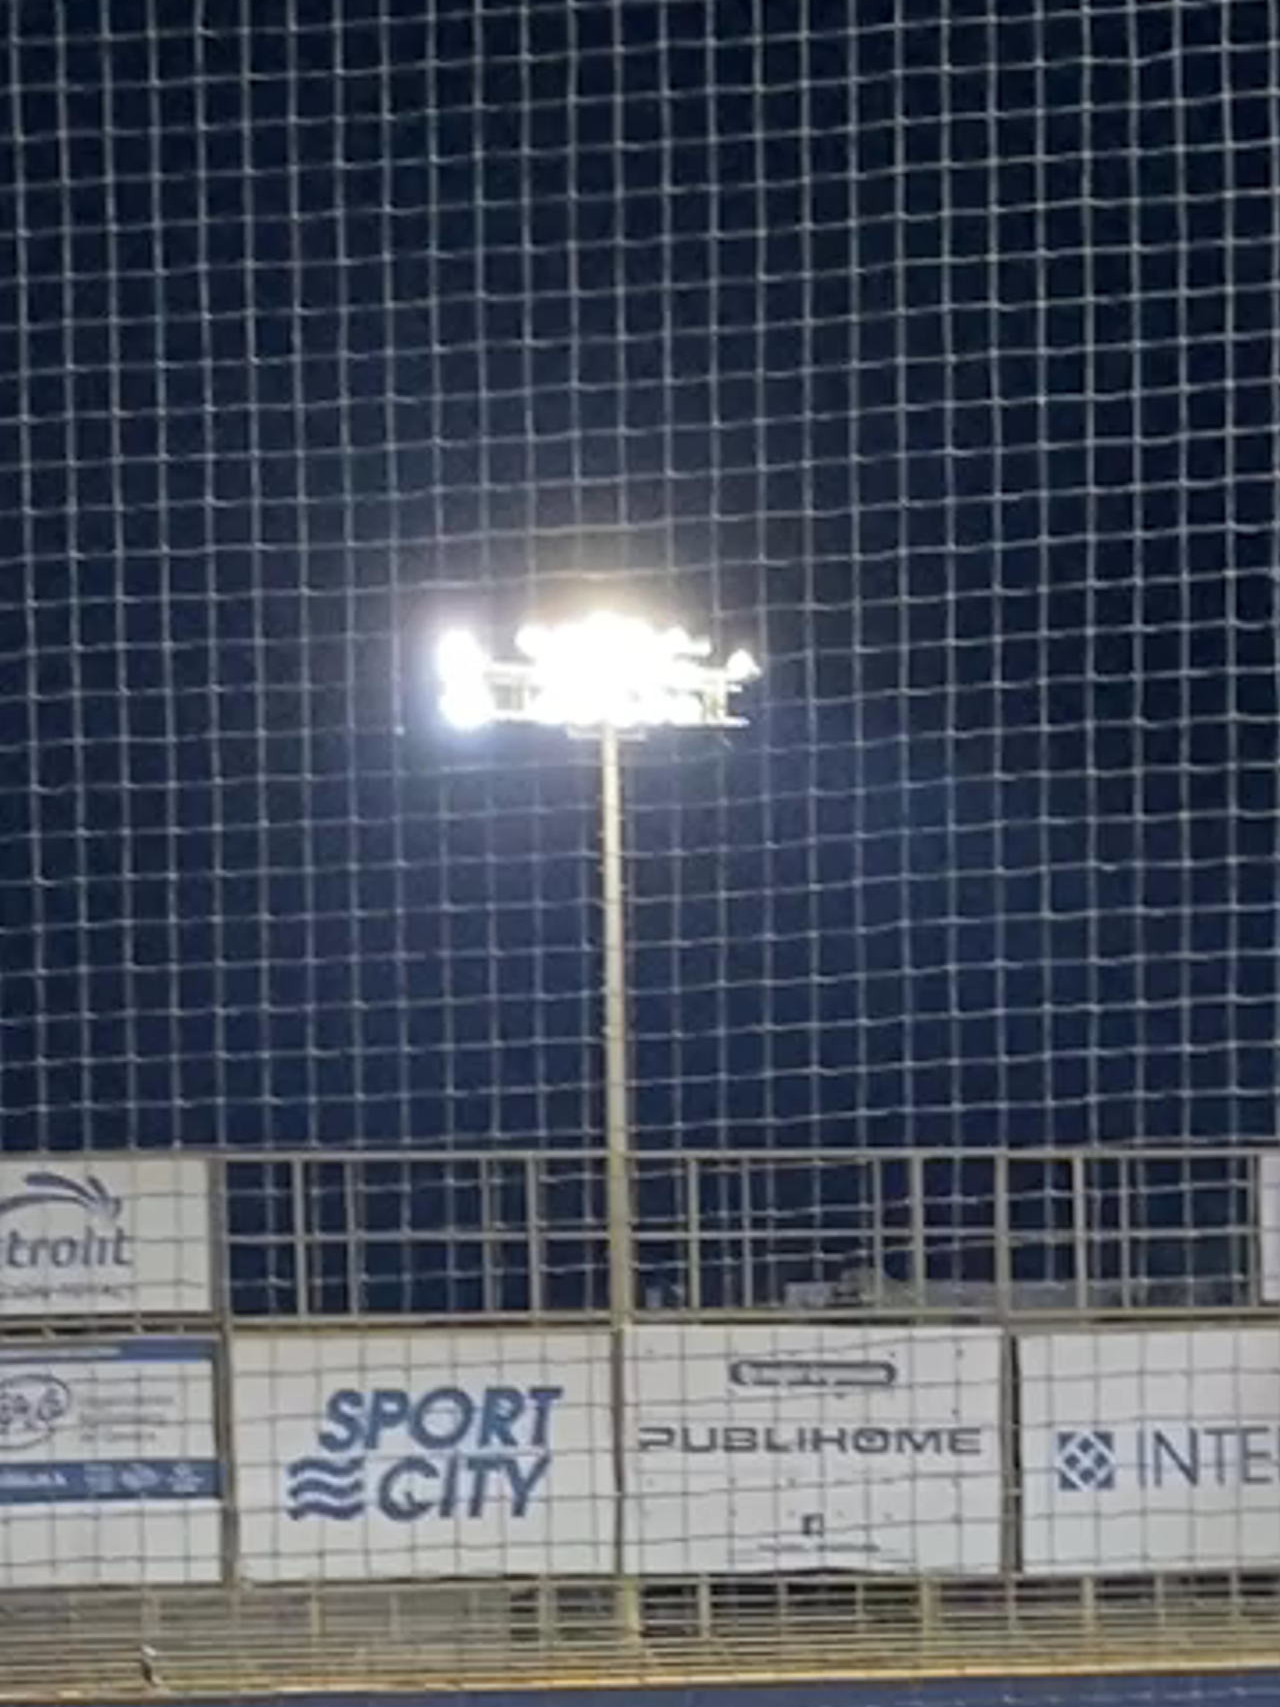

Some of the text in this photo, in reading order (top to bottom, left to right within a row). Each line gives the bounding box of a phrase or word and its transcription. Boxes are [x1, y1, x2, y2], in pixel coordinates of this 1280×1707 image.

[318, 1387, 563, 1452] SPORT
[638, 1427, 982, 1455] PUBLIHOME
[377, 1456, 551, 1521] CITY
